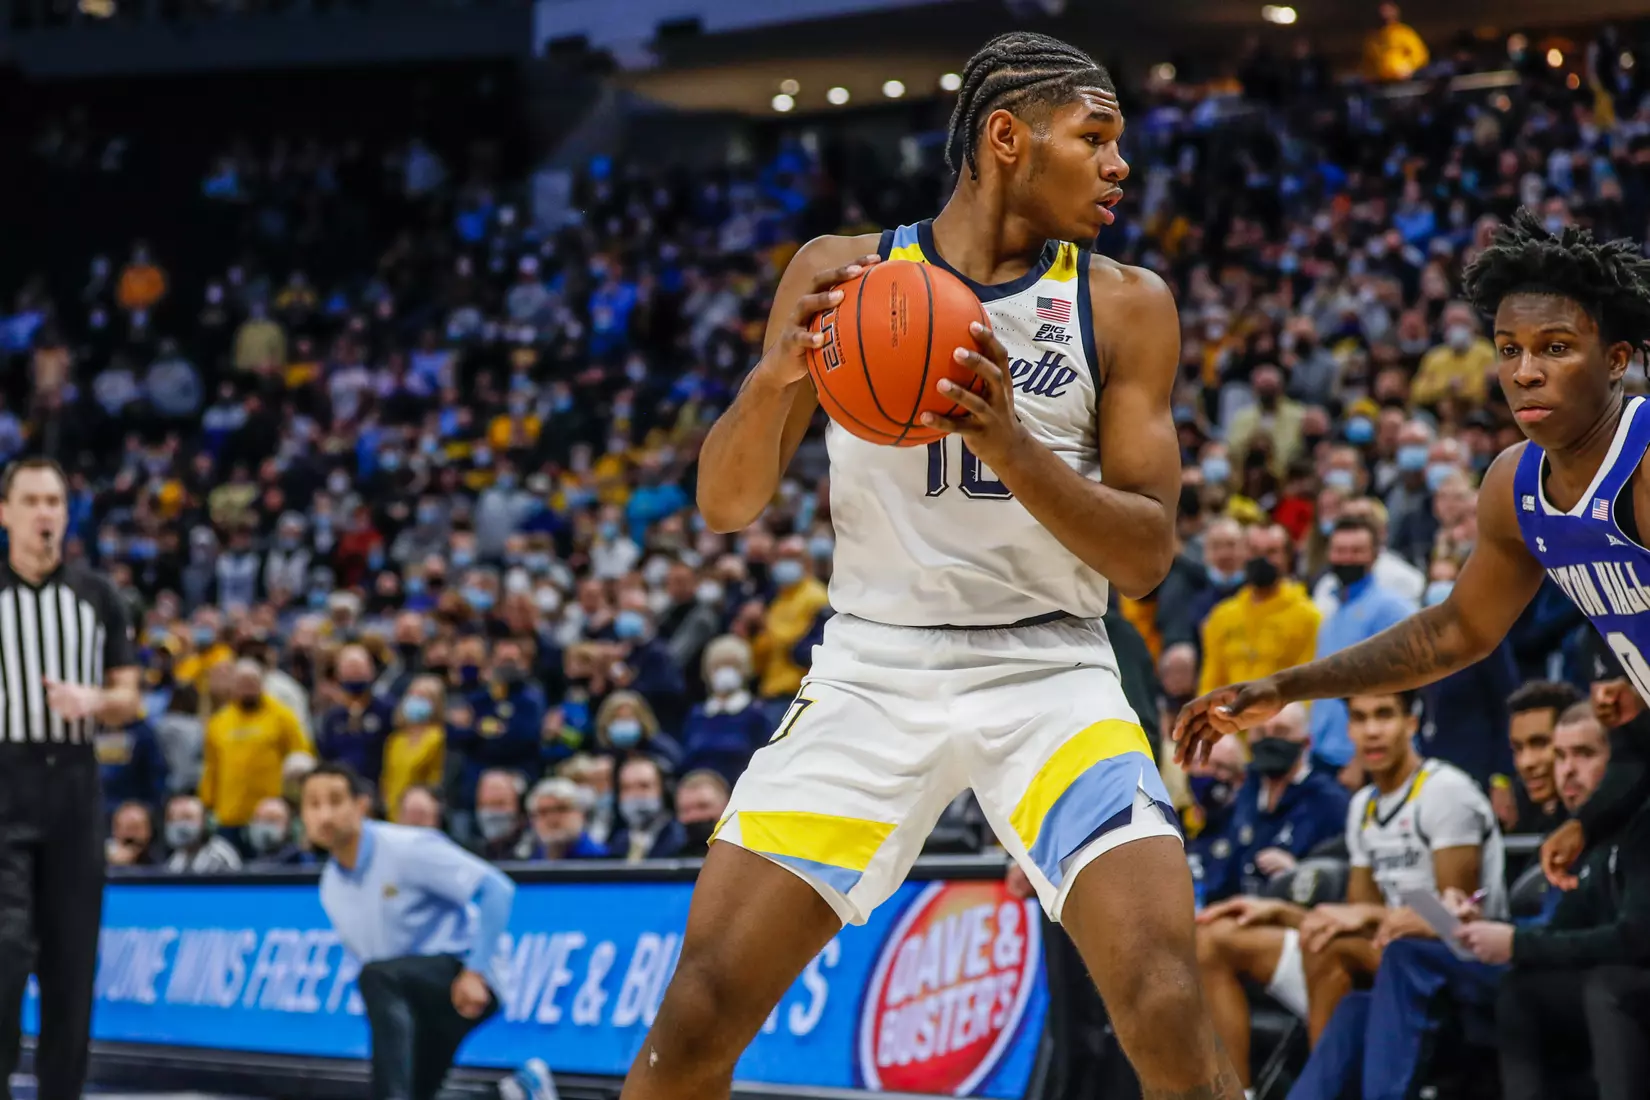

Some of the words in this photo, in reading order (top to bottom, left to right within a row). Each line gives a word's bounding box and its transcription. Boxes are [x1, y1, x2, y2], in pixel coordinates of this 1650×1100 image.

[1034, 331, 1073, 343] EAST
[1039, 323, 1066, 334] BIG
[1008, 350, 1078, 398] ette
[1547, 563, 1609, 617] TON
[885, 903, 995, 1006] DAVE
[992, 900, 1025, 970] &
[571, 940, 617, 1027] &
